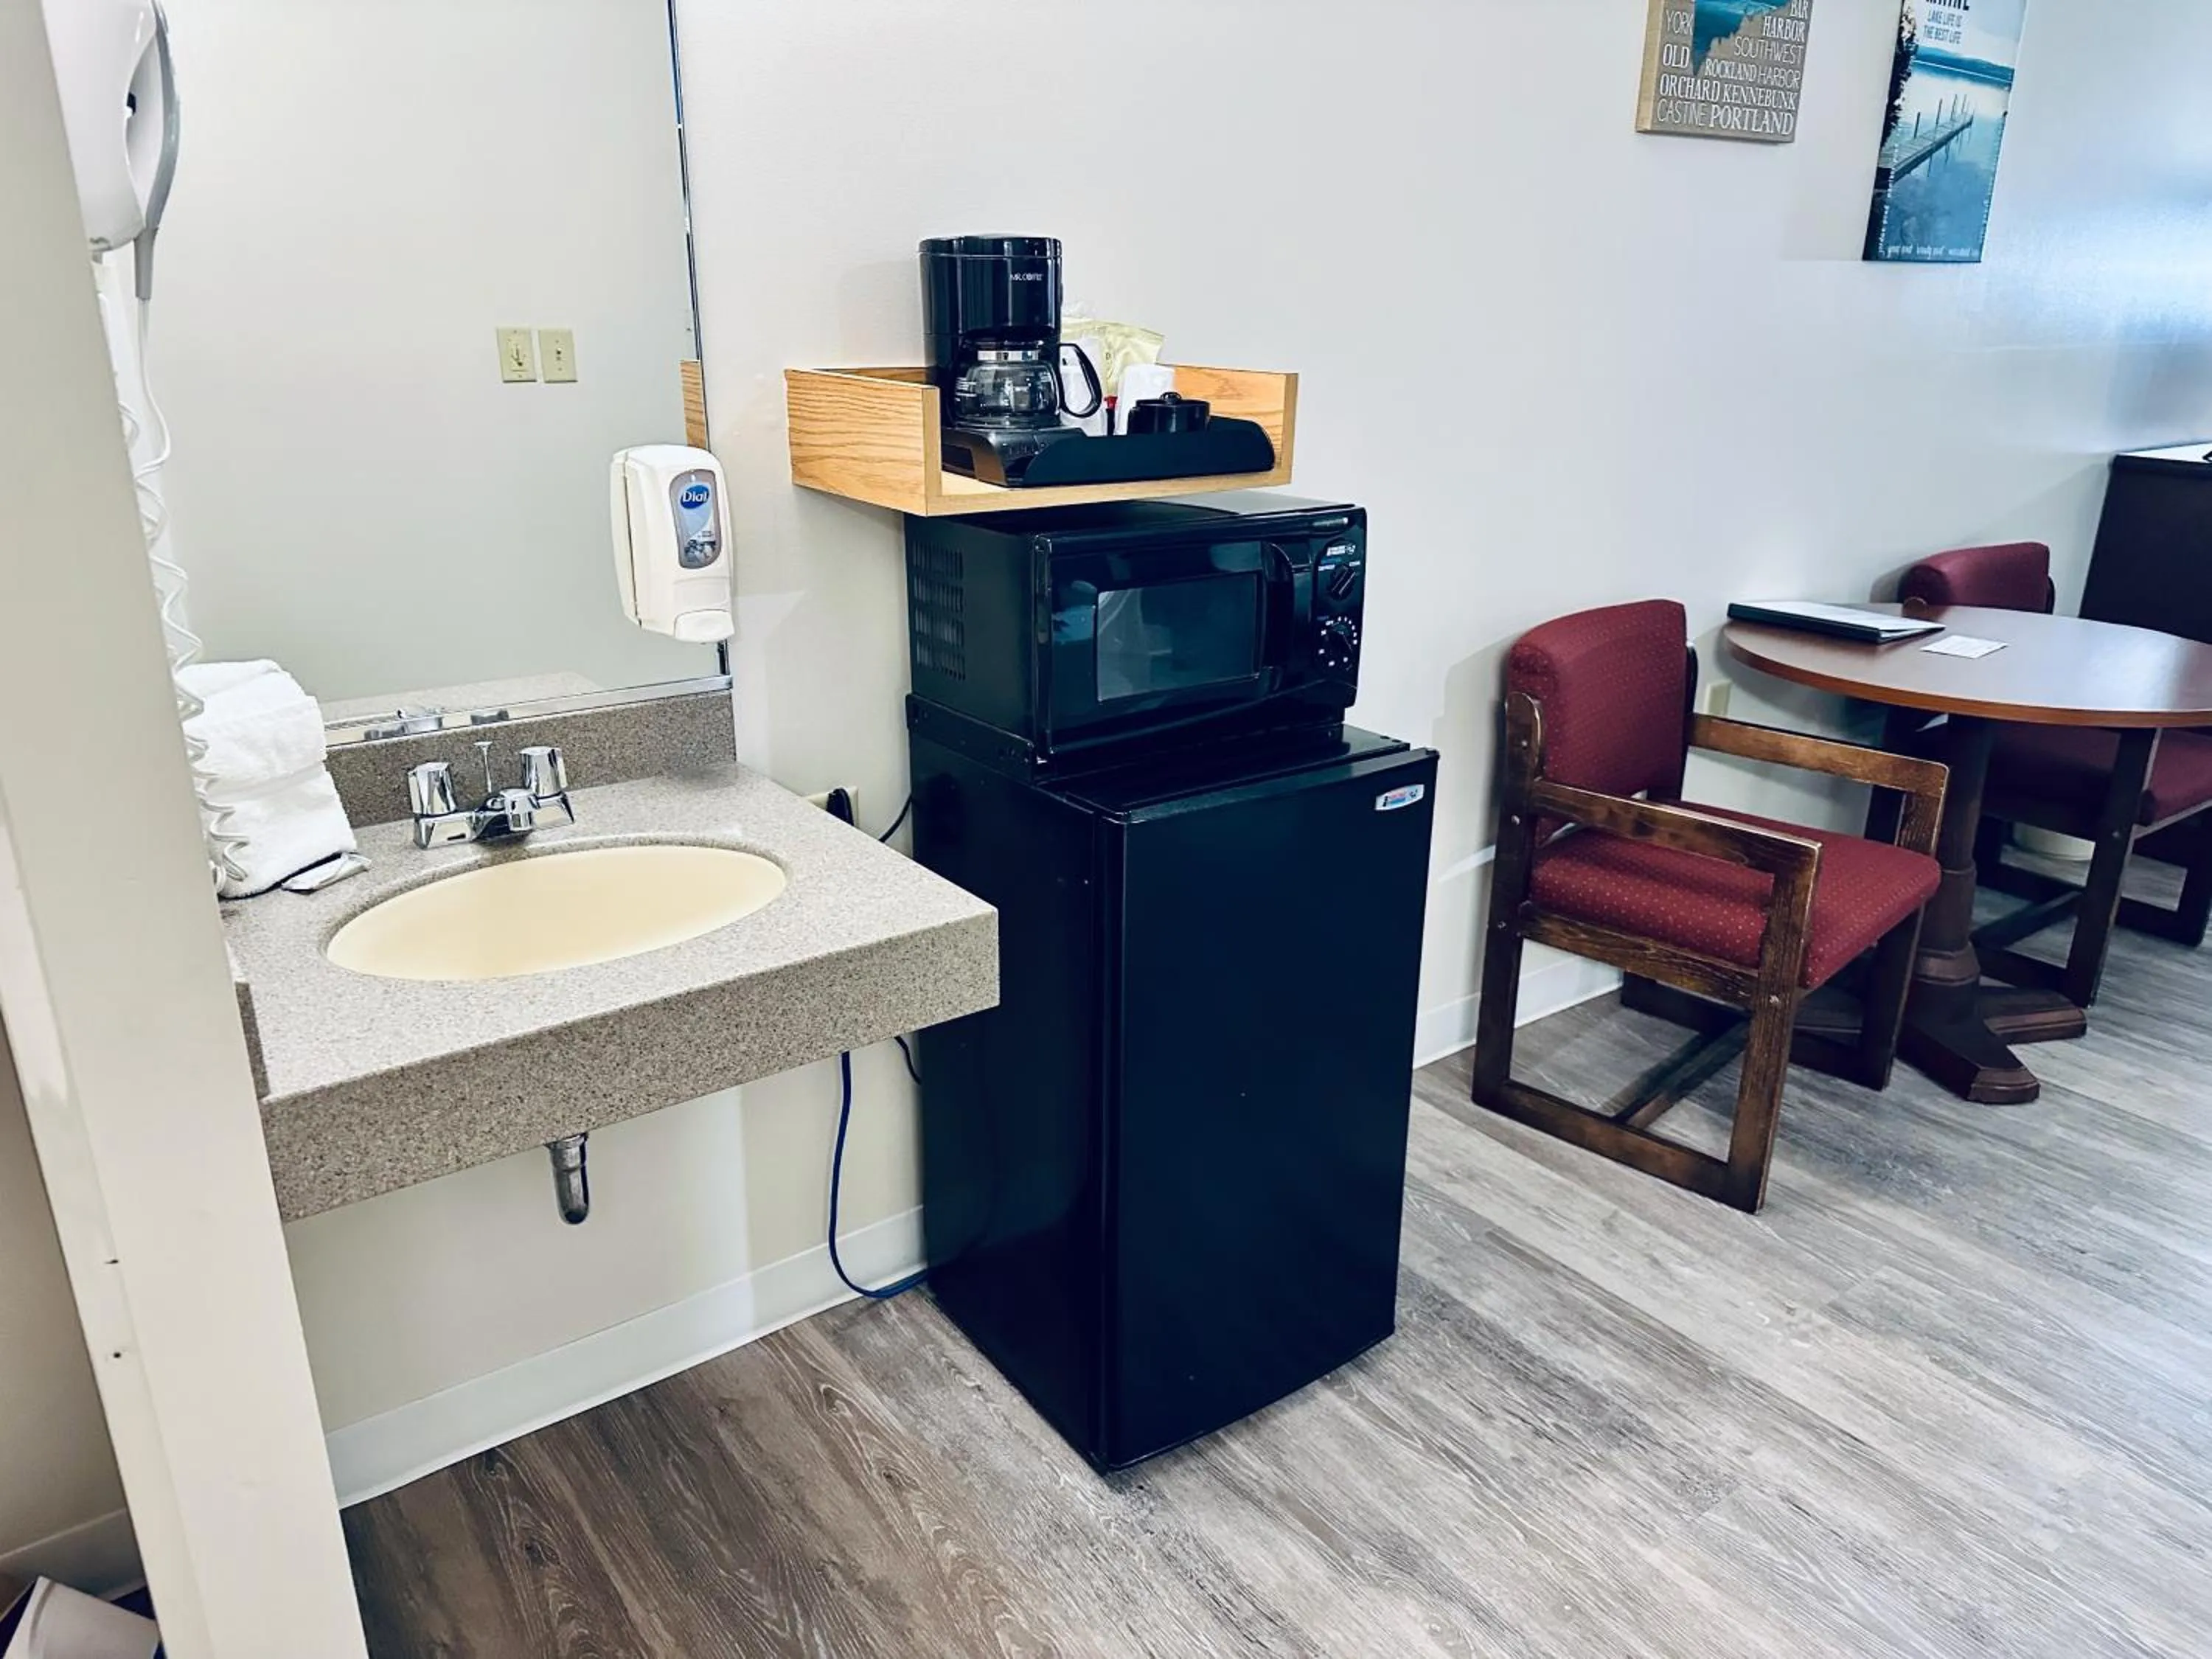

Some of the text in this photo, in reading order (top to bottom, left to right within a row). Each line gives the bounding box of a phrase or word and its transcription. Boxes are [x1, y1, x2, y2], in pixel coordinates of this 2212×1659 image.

[1666, 9, 1694, 35] YORK
[1762, 15, 1806, 42] HARBOR
[1663, 44, 1690, 68] OLD
[1733, 36, 1804, 64] SOUTHWEST
[1705, 58, 1801, 88] ROCKLAND HARBOR
[1660, 73, 1798, 110] ORCHARD KENNEBUNK
[1657, 98, 1794, 135] CASTINE PORTLAND
[682, 490, 707, 502] Dial
